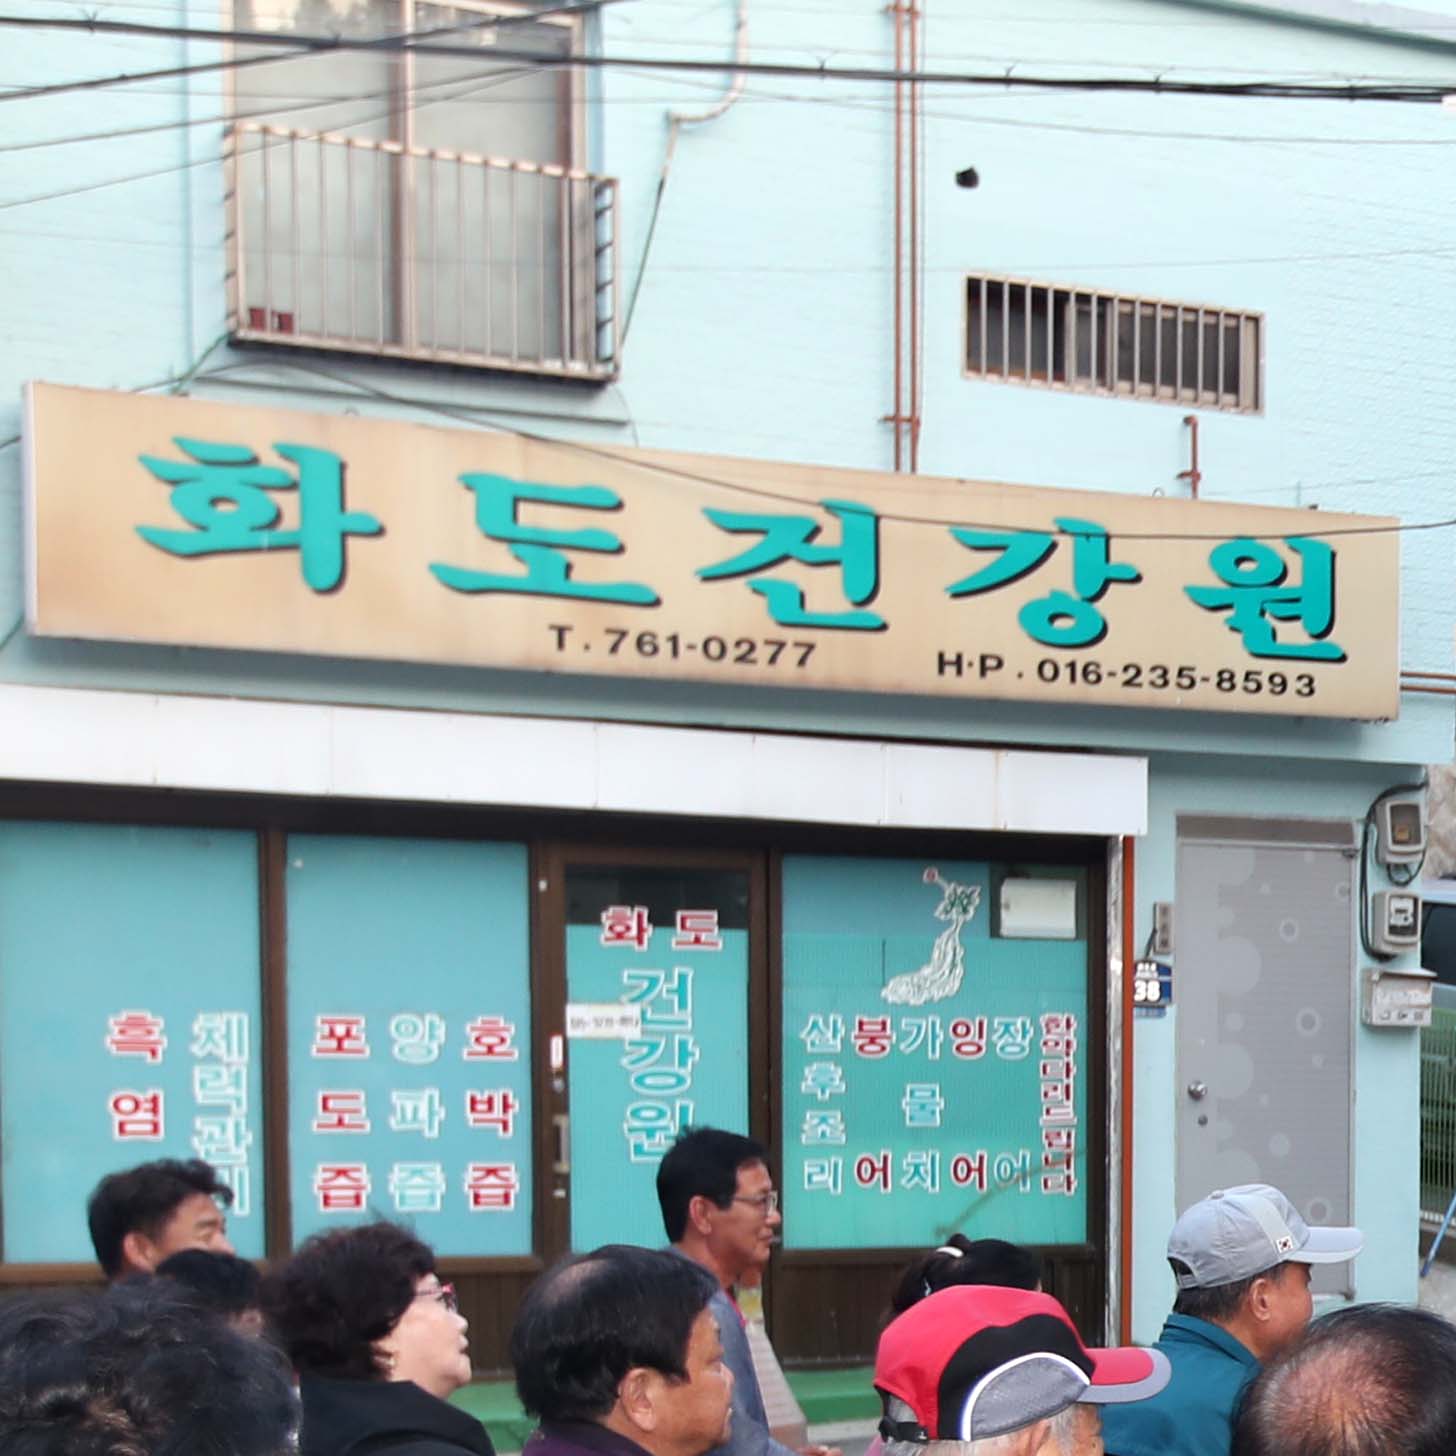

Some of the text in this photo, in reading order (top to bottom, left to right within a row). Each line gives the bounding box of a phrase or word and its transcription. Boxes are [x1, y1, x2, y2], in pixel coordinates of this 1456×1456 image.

[135, 435, 1348, 664] 화도건강원
[606, 630, 815, 668] 761-0277
[1037, 657, 1317, 698] 016-235-8593
[600, 905, 723, 950] 화도
[1133, 979, 1161, 1002] 38
[311, 1014, 370, 1212] 포도즙
[389, 1013, 445, 1212] 양파즙
[463, 1015, 519, 1212] 호박즙
[620, 965, 699, 1164] 건강원
[801, 1012, 847, 1196] 산후조리
[851, 1012, 896, 1193] 붕어
[899, 1014, 945, 1193] 가물치
[949, 1014, 989, 1192] 잉어
[991, 1014, 1034, 1194] 장어
